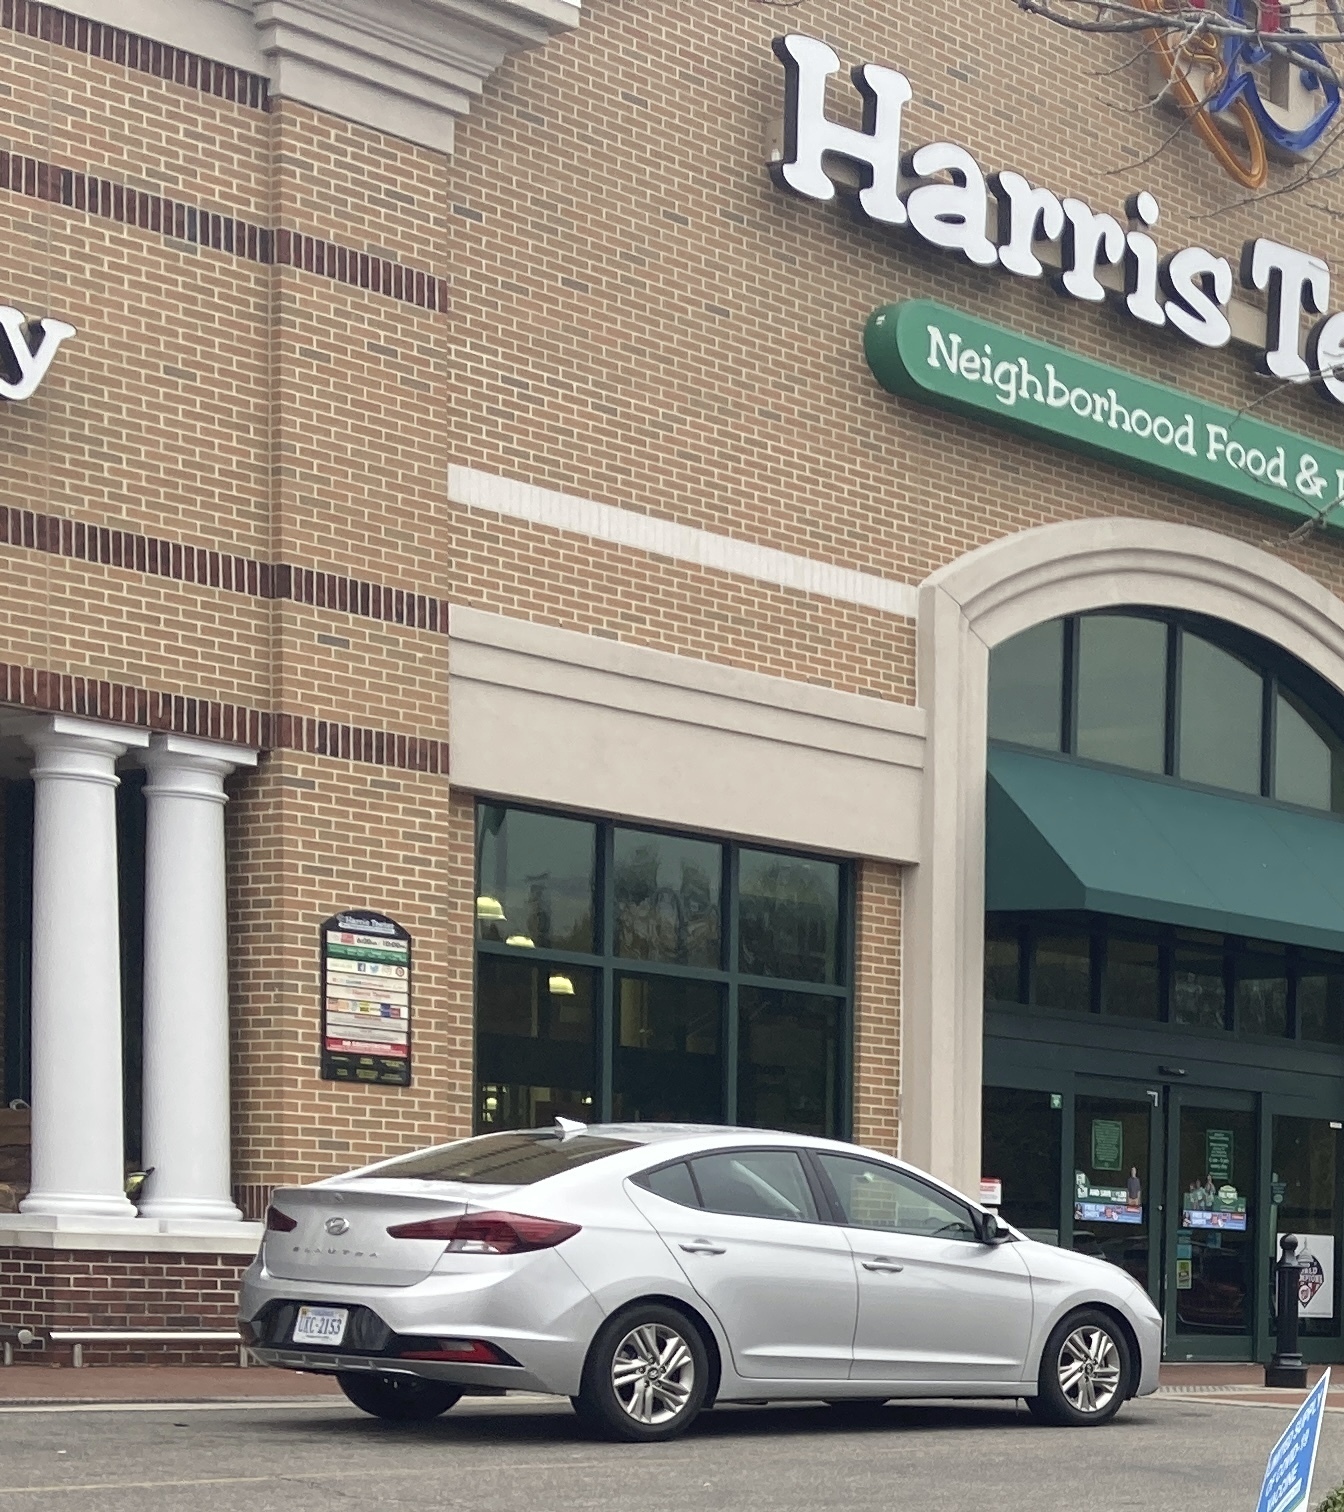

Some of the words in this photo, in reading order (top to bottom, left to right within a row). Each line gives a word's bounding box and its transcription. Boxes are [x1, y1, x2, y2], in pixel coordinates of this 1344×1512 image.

[778, 33, 1233, 349] Harris
[926, 326, 1198, 459] Neighborhood
[1206, 422, 1287, 492] Food
[1295, 454, 1328, 500] &
